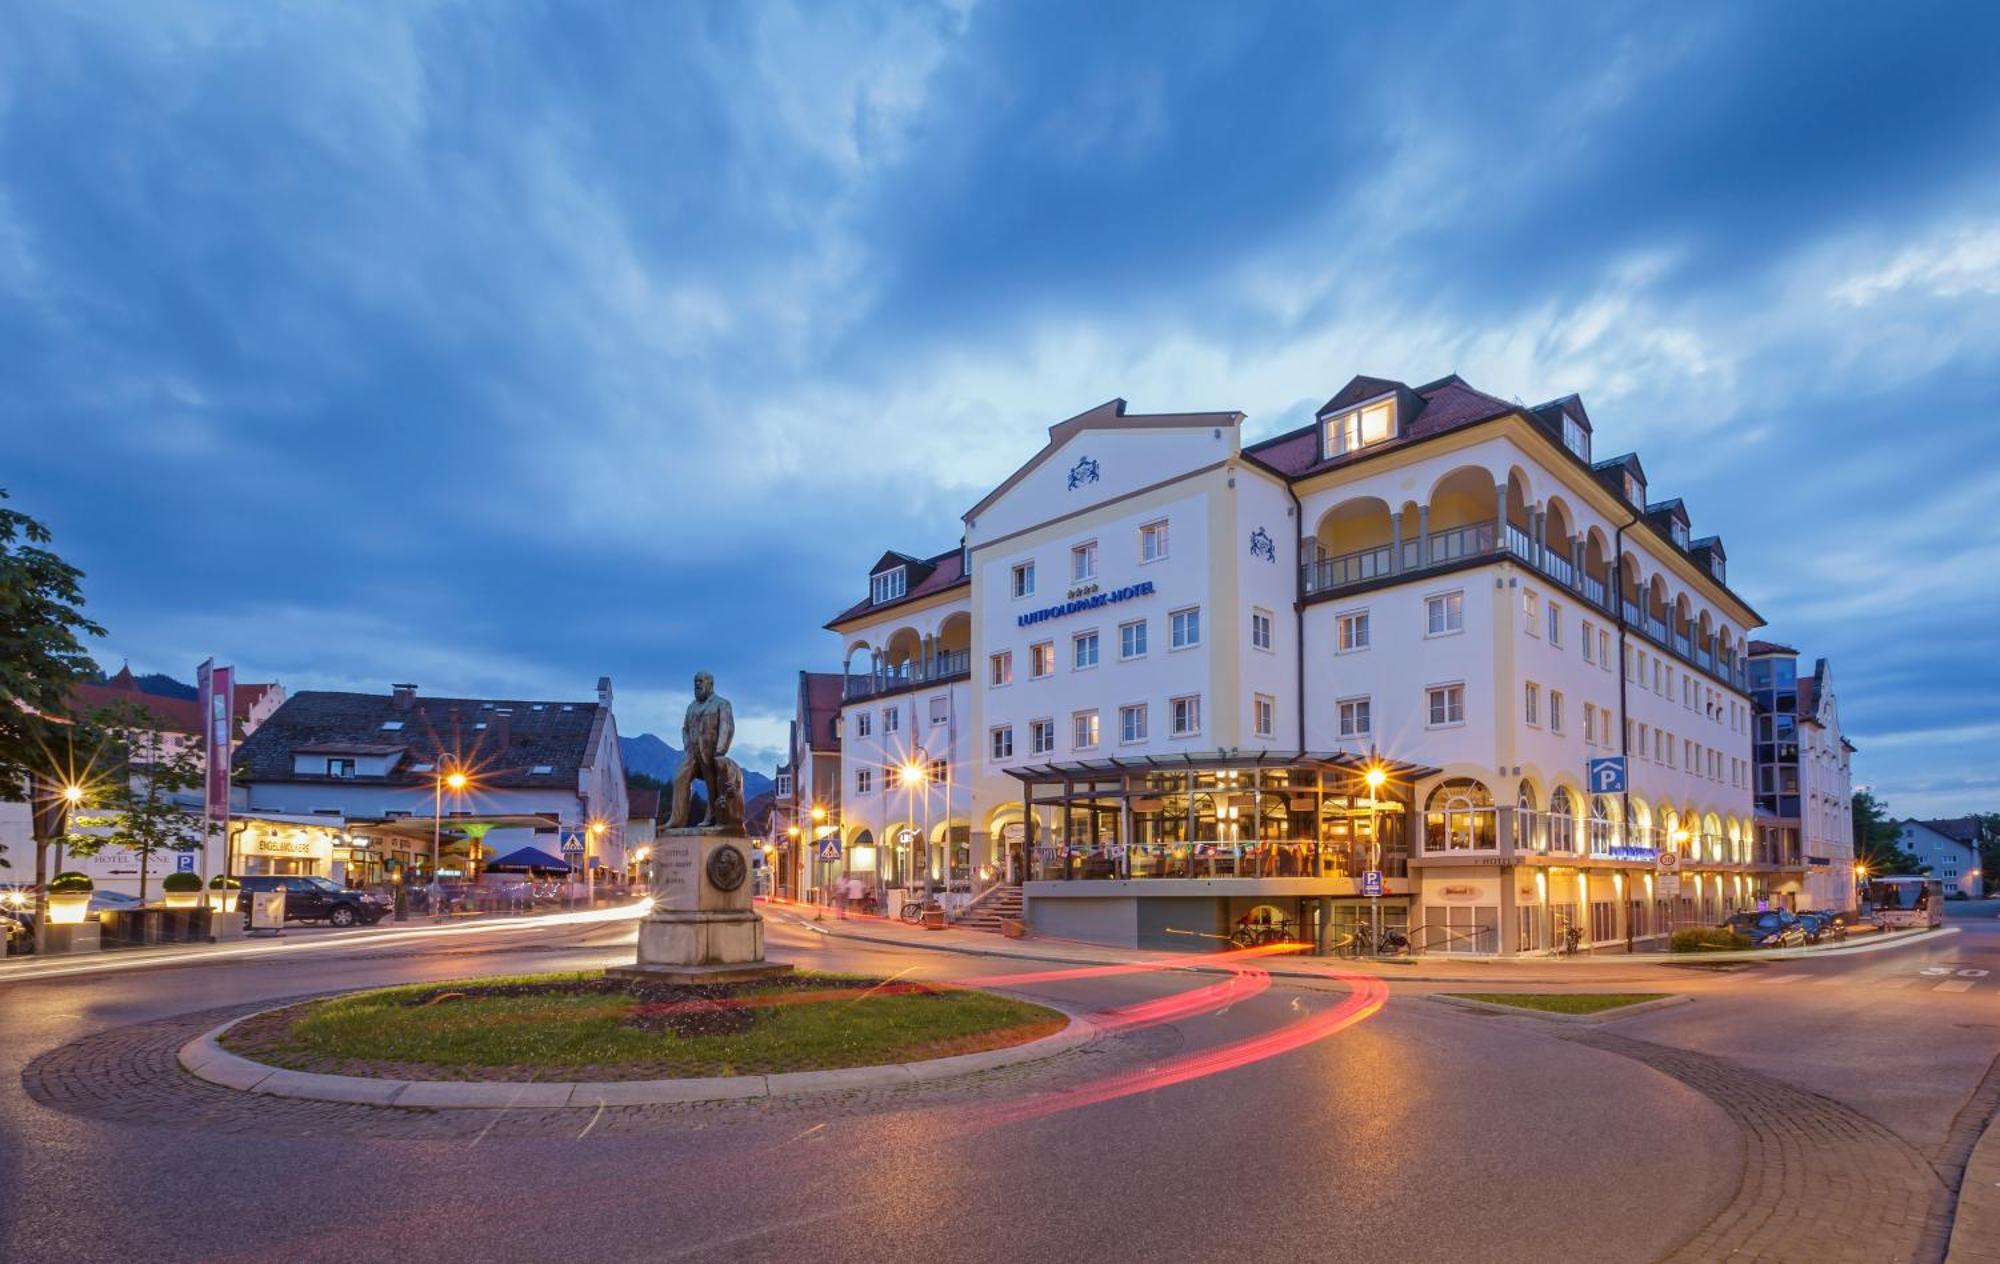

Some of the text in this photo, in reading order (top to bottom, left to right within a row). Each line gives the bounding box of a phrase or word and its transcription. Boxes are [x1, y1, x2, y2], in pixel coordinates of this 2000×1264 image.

[1018, 581, 1155, 626] LUITPOLDPARK-HOTEL
[1601, 770, 1616, 790] P
[94, 855, 130, 864] HOTEL
[181, 856, 191, 868] P
[1367, 872, 1377, 885] P
